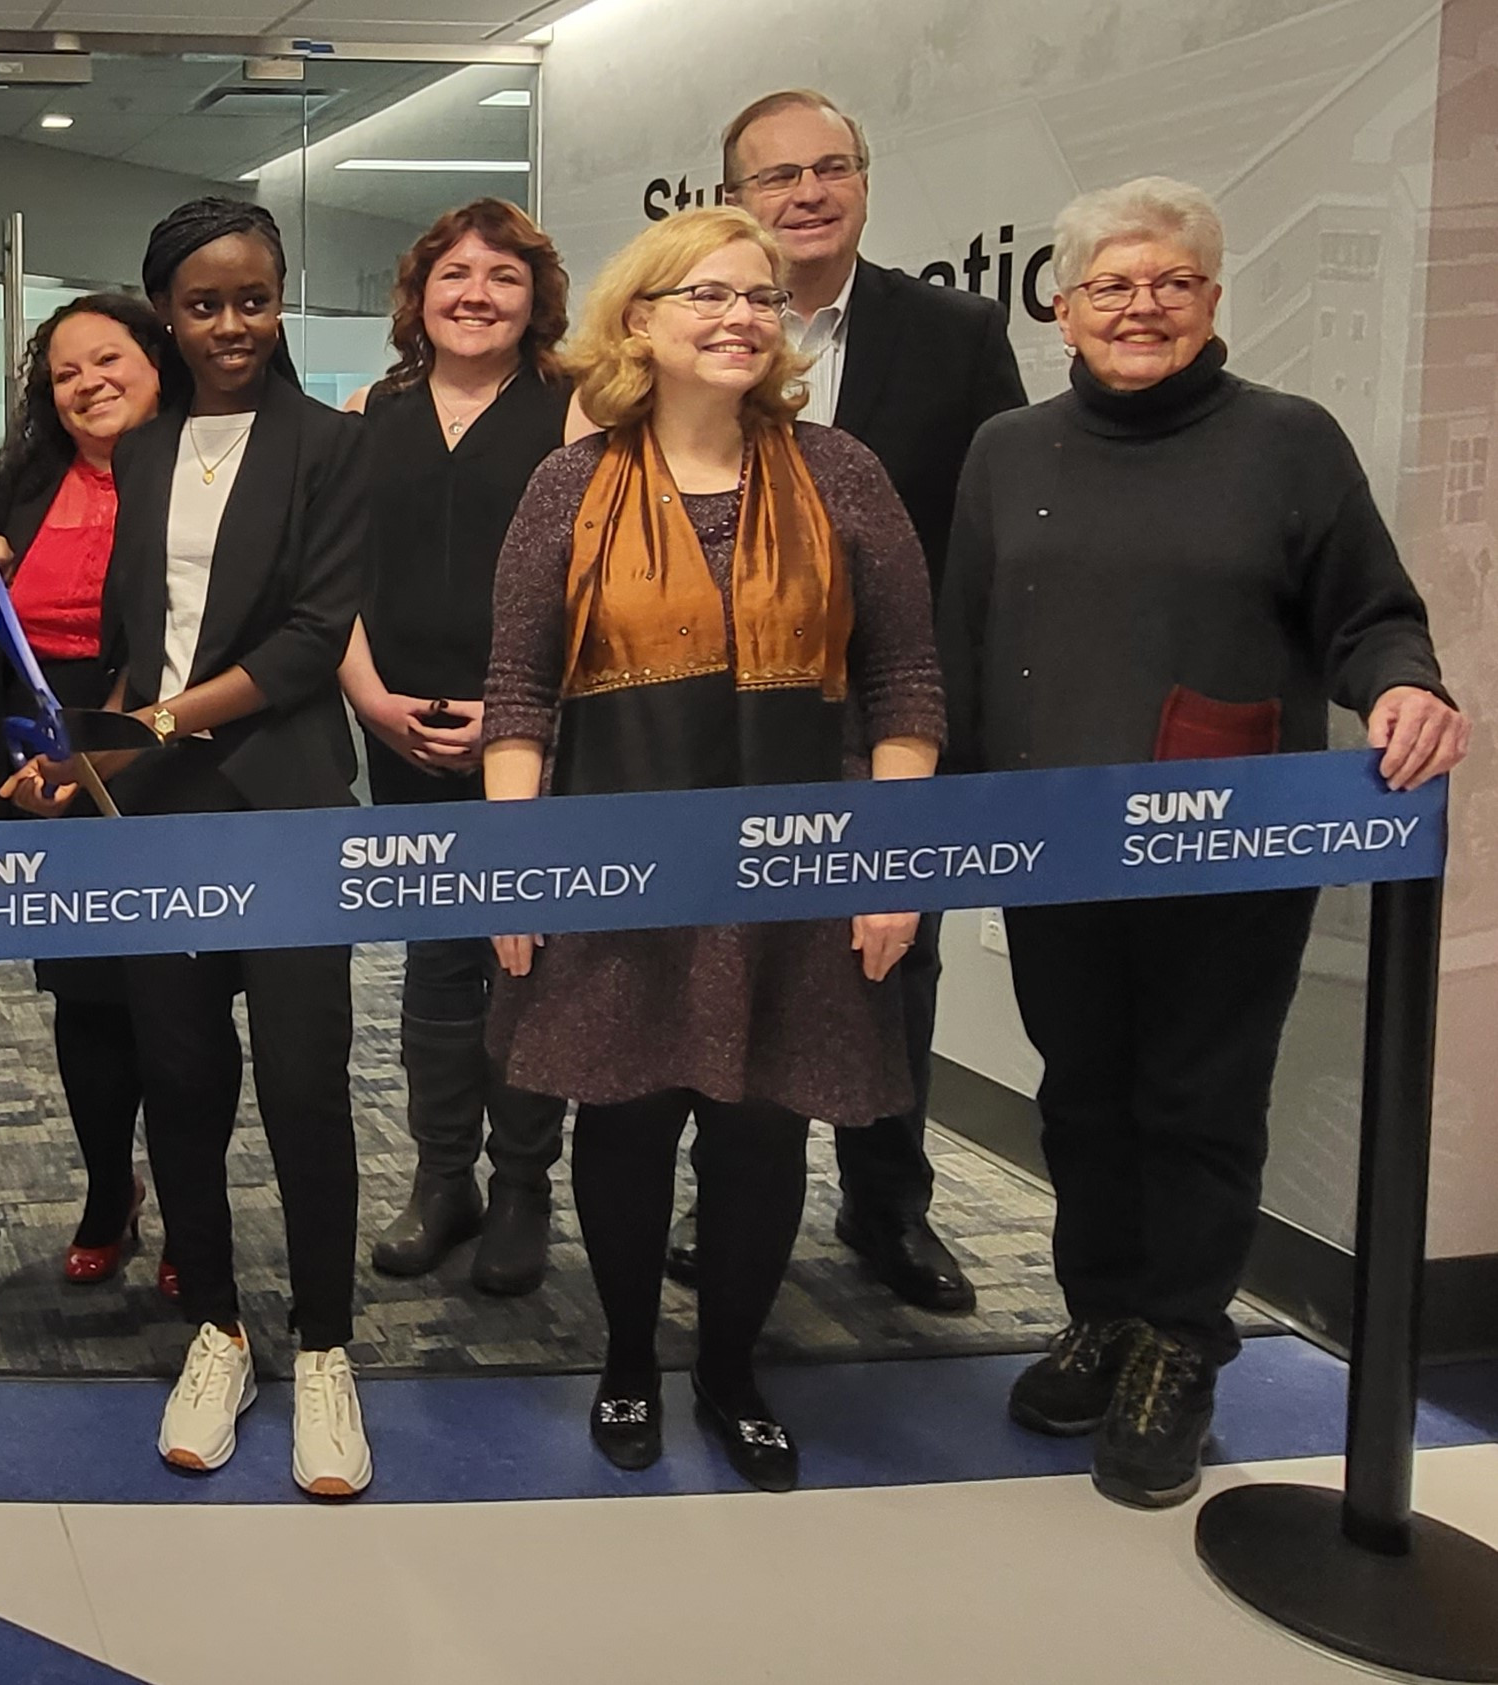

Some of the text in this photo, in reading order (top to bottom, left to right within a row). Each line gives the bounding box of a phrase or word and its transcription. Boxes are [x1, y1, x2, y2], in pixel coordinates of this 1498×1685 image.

[644, 174, 724, 222] Stu
[738, 812, 852, 848] SUNY
[1124, 788, 1233, 825] SUNY
[340, 833, 457, 868] SUNY
[736, 841, 1045, 890] SCHENECTADY
[1120, 817, 1420, 867] SCHENECTADY
[340, 863, 656, 911] SCHENECTADY
